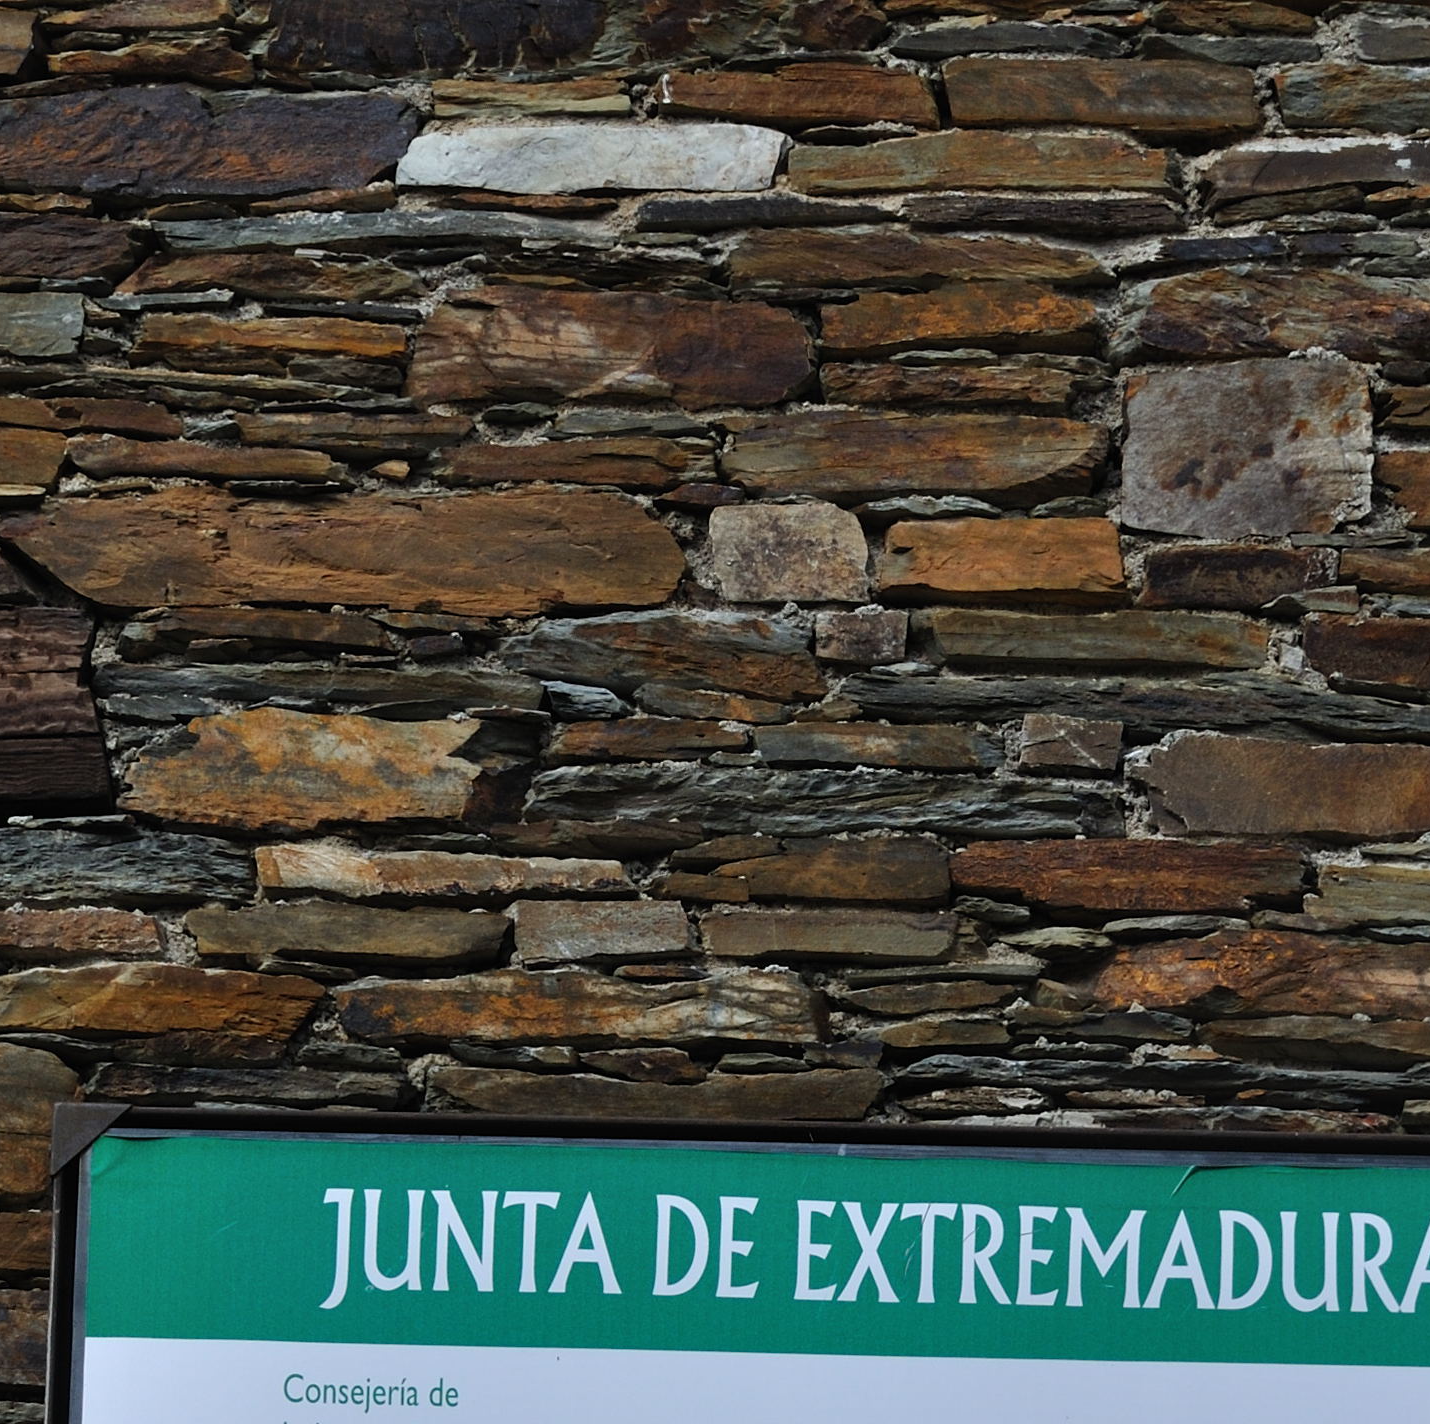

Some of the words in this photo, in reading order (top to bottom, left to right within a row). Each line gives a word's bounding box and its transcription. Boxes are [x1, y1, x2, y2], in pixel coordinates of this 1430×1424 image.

[319, 1187, 622, 1310] JUNTA
[652, 1194, 759, 1299] DE
[283, 1373, 419, 1413] Consejería
[429, 1377, 459, 1408] de
